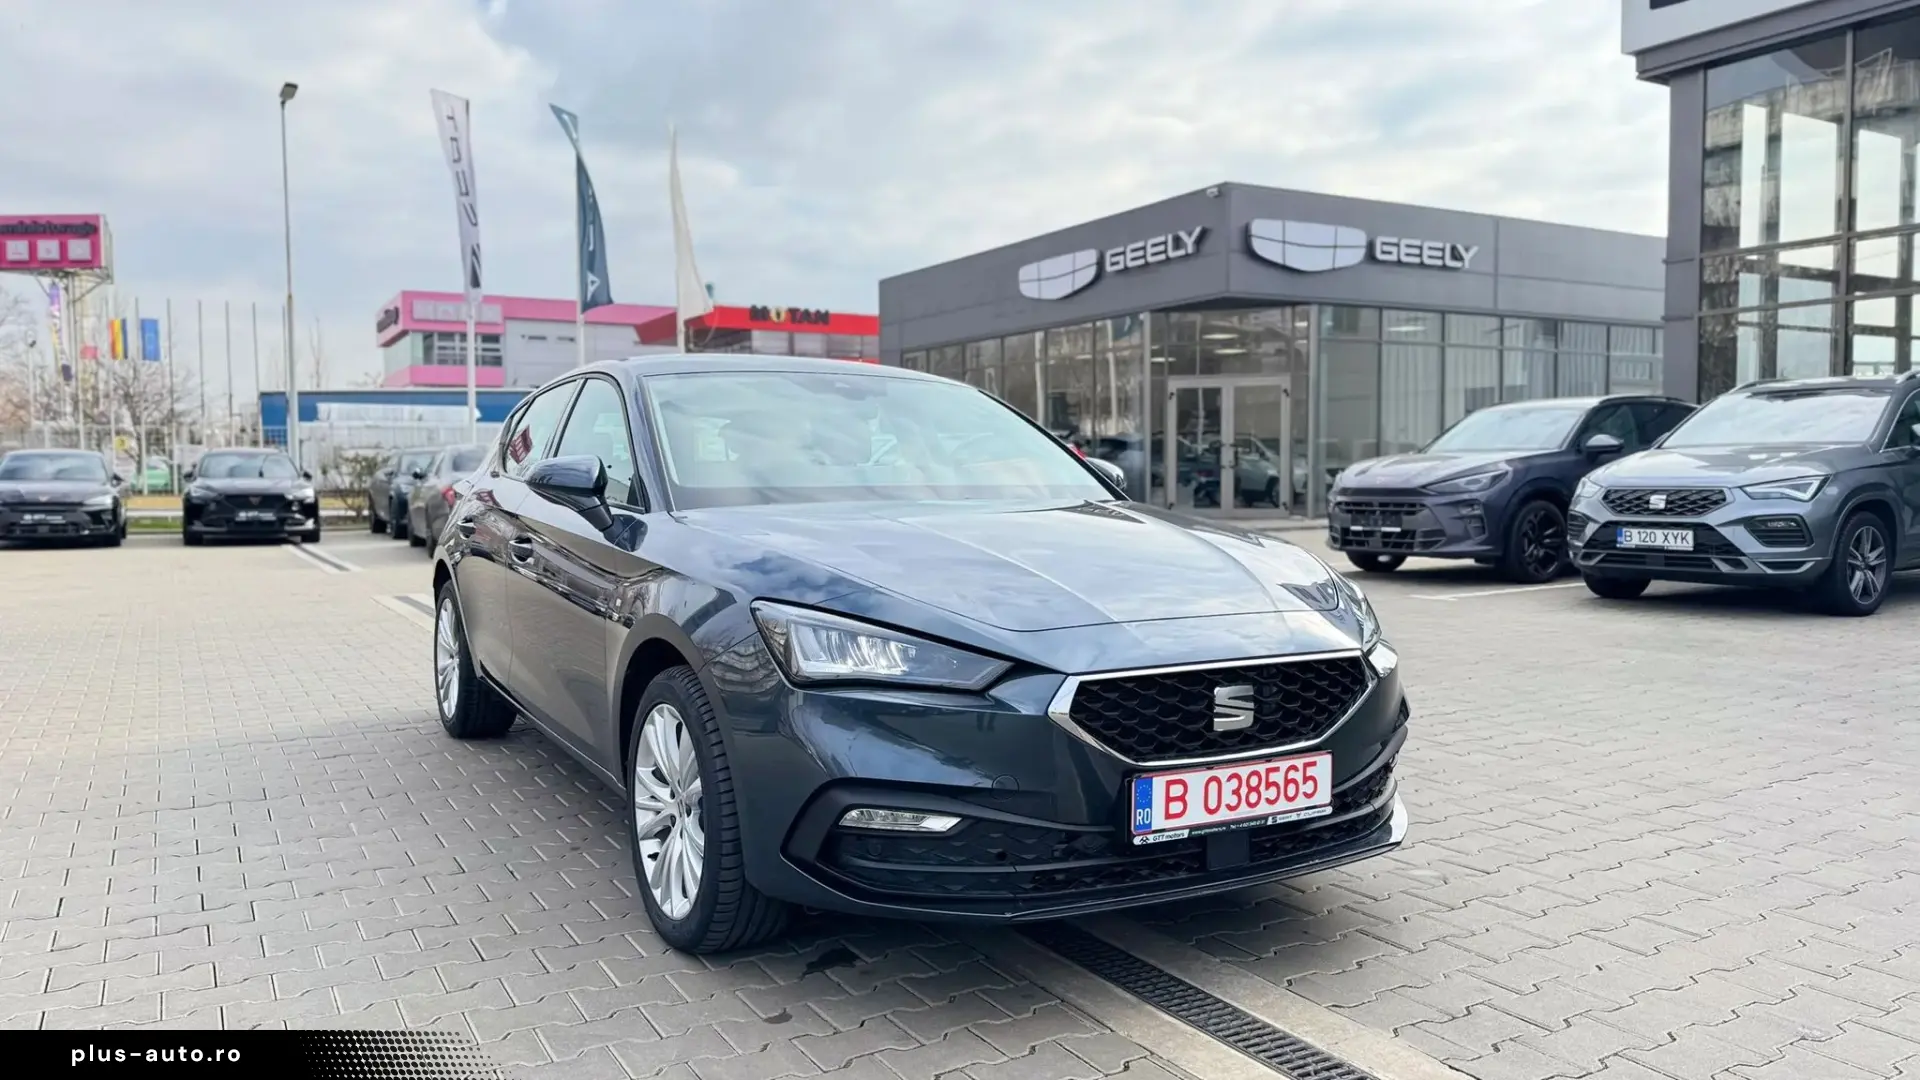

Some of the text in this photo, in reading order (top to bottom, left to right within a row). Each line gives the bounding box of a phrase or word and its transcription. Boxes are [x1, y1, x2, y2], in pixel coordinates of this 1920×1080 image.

[1105, 225, 1202, 272] GEELY
[1376, 236, 1479, 269] GEELY
[1624, 530, 1633, 543] B
[1637, 531, 1657, 544] 120
[1662, 531, 1690, 545] XYK
[1164, 760, 1318, 821] B 038565
[1136, 808, 1151, 826] RO
